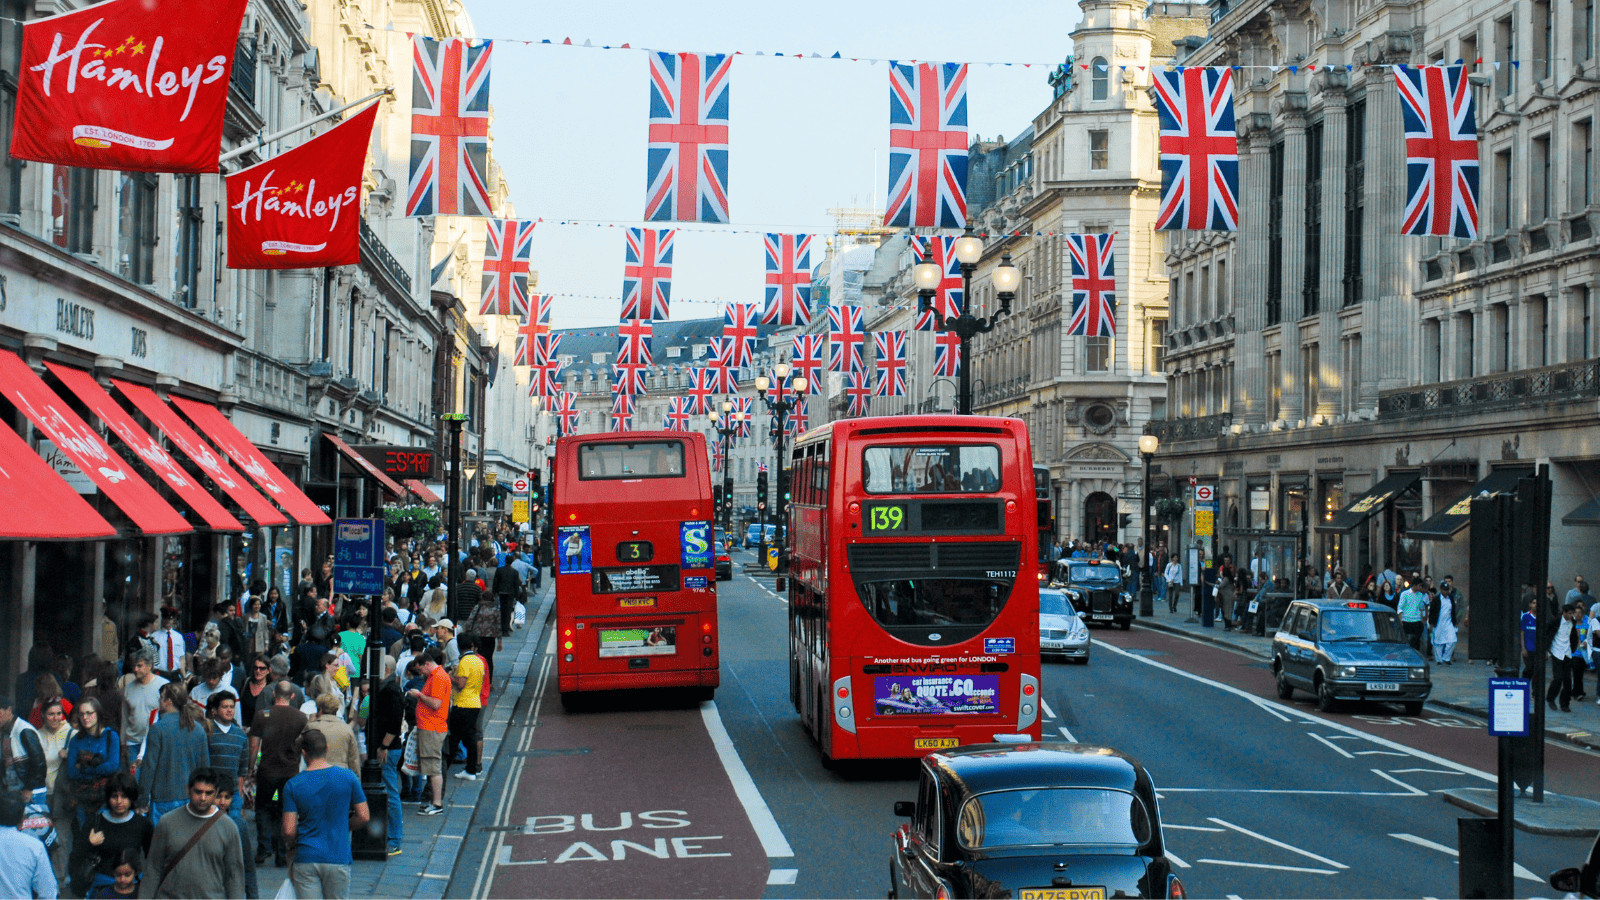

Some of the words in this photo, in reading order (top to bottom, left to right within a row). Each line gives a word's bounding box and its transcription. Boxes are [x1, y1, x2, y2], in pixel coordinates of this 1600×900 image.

[30, 17, 226, 122] Hamleys
[102, 130, 135, 144] LONDON
[232, 169, 357, 232] Hamleys
[56, 297, 95, 342] HAMLEYS
[386, 451, 432, 473] ESPRIT
[870, 506, 903, 530] 139
[629, 543, 640, 559] 3
[986, 570, 1016, 578] TEH1112
[916, 685, 948, 697] QUOTE
[525, 810, 692, 835] BUS
[498, 835, 732, 866] LANE
